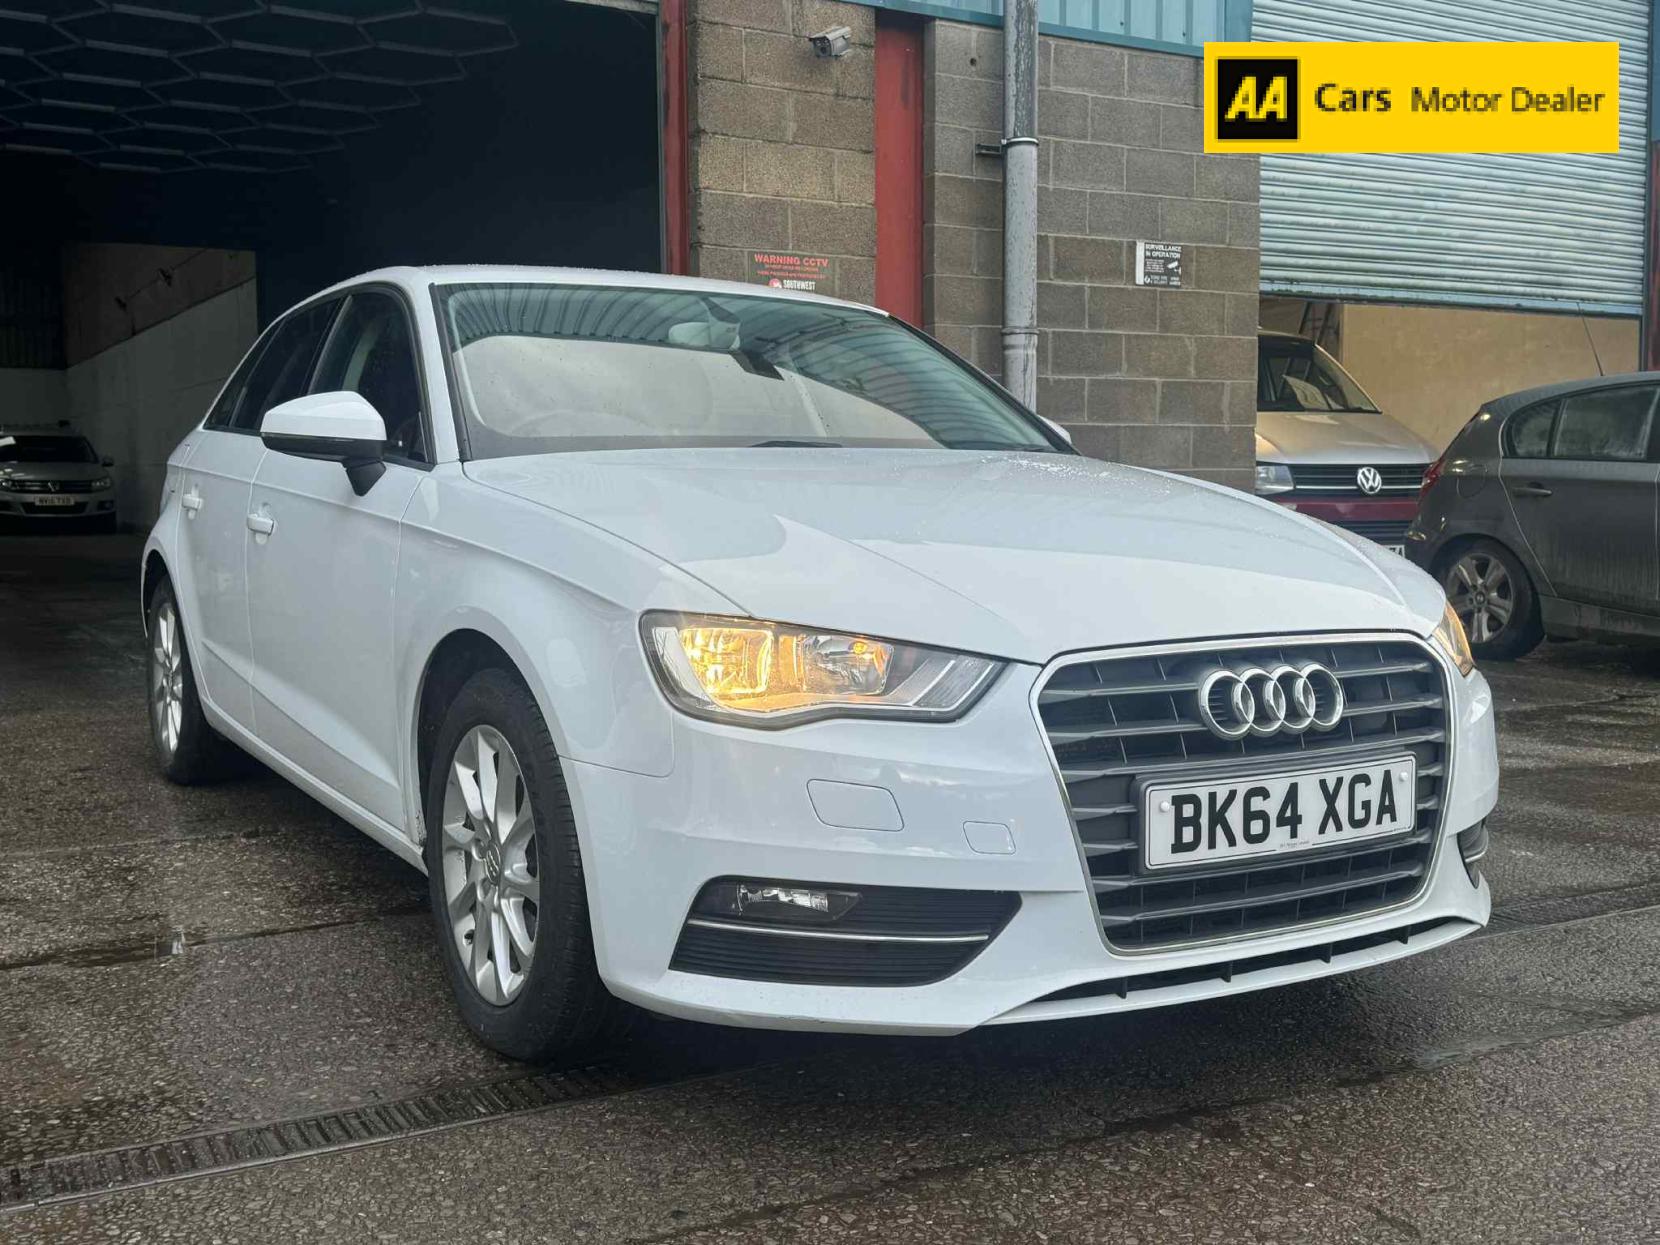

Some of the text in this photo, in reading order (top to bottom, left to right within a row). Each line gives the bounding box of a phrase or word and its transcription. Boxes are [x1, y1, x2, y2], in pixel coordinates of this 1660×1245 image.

[754, 253, 829, 267] WARNING CCTV
[1152, 251, 1181, 259] OPERATION
[783, 279, 816, 291] SOUTHWEST
[1171, 769, 1398, 854] BK64 XGA
